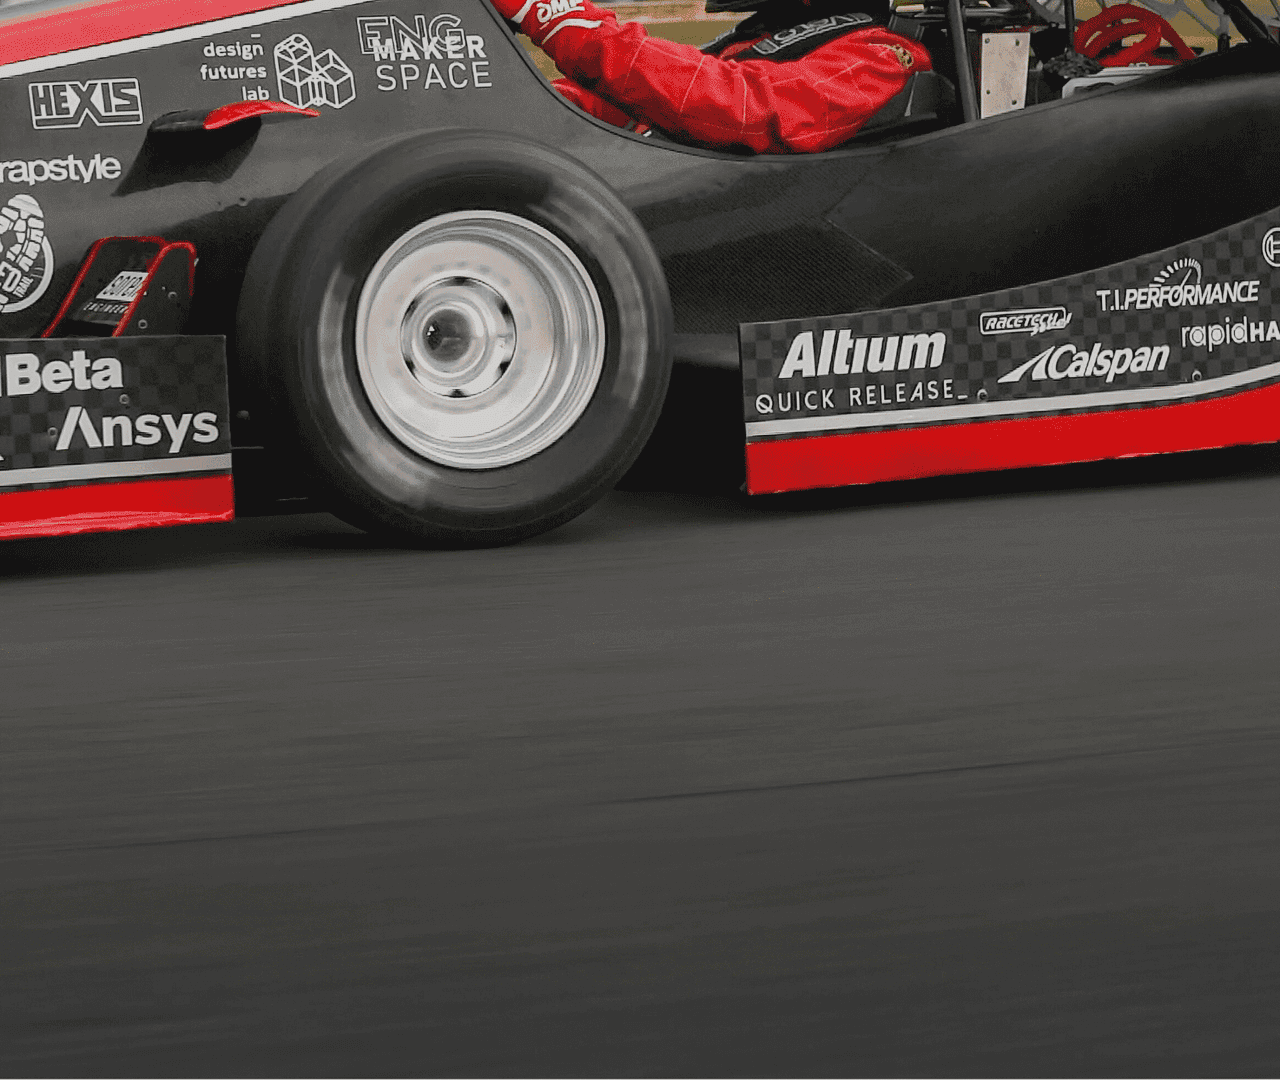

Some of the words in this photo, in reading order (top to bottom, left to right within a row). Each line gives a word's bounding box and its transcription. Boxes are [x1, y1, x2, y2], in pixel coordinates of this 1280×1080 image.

[356, 14, 464, 55] ENG
[372, 35, 487, 62] MAKER
[203, 41, 264, 61] design
[200, 64, 267, 80] futures
[376, 61, 492, 90] SPACE
[31, 81, 140, 122] HEXIS
[242, 86, 270, 101] lab
[13, 277, 34, 298] TRAIL
[778, 329, 947, 379] Altium
[1048, 342, 1170, 383] Calspan
[5, 350, 124, 396] Beta
[755, 388, 835, 414] QUICK
[56, 406, 219, 453] Ansys
